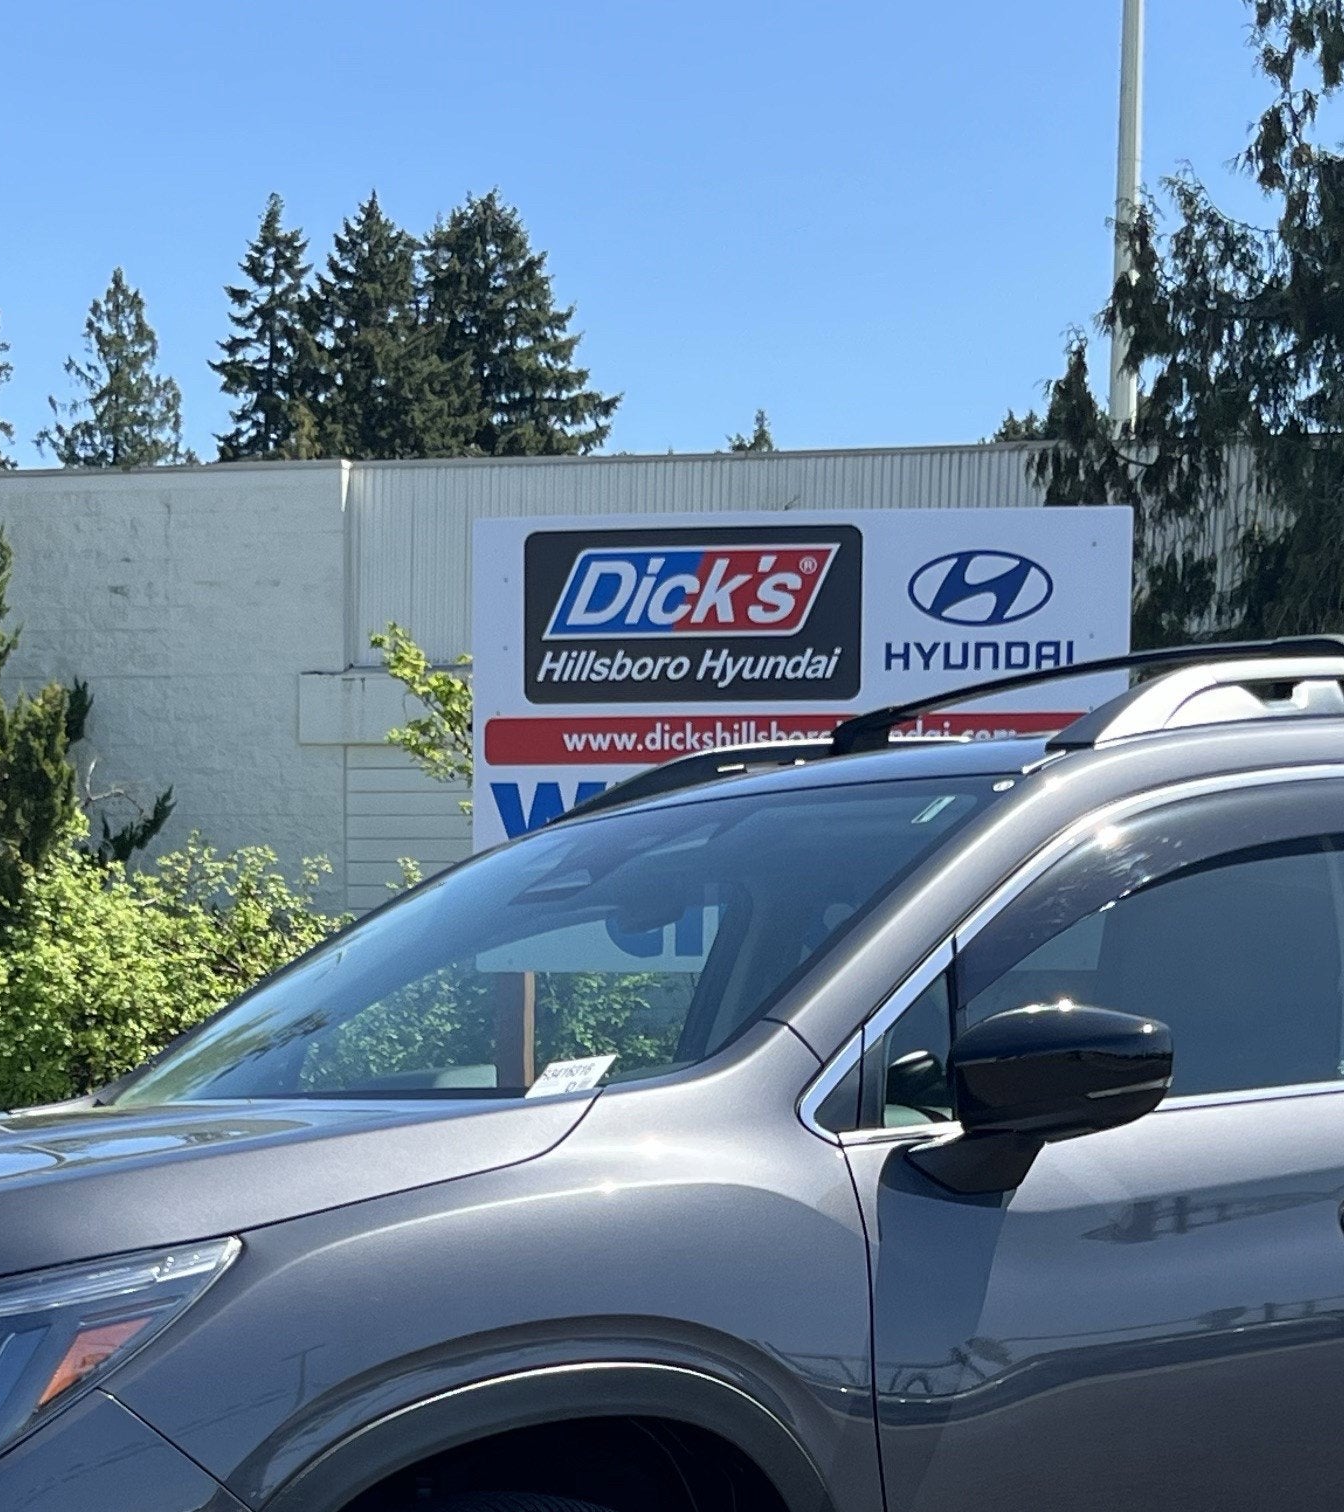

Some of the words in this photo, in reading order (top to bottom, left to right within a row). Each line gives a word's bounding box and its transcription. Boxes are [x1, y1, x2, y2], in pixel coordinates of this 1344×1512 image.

[536, 650, 690, 683] Hillsboro
[696, 646, 842, 688] Hyundai
[884, 640, 1074, 671] HYUNDAI
